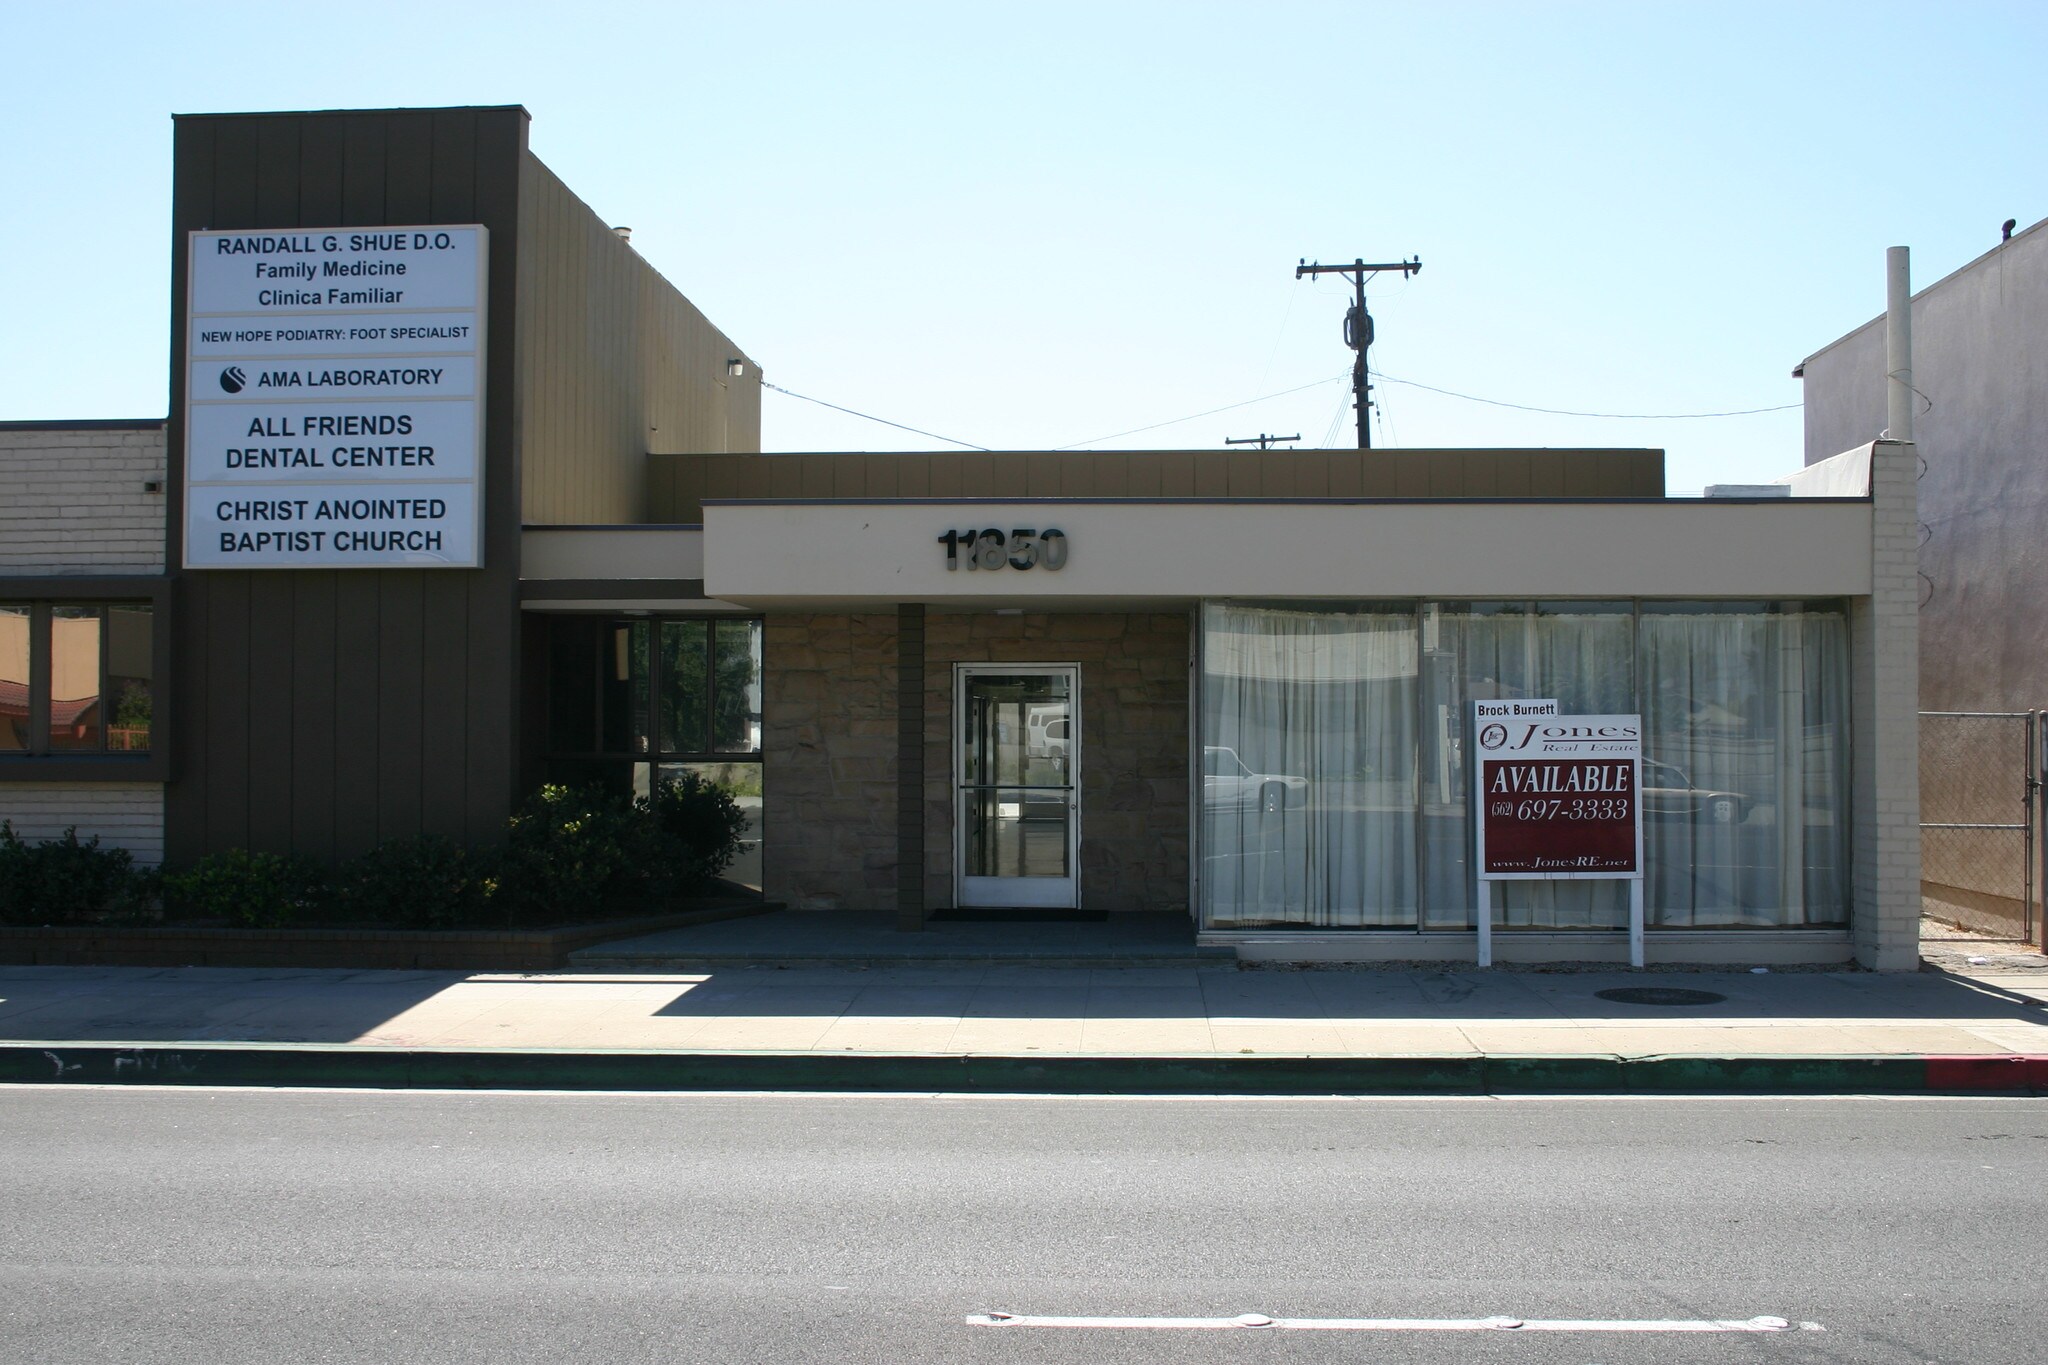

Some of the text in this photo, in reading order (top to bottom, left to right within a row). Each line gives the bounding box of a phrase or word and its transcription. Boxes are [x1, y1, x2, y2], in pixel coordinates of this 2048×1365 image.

[217, 233, 456, 255] RANDALL G. SHUE D.O.
[256, 260, 407, 281] Family Medicine
[258, 288, 403, 305] Clinica Familiar
[201, 326, 469, 343] NEW HOPE PODIATRY: FOOT SPECIALIST
[258, 369, 443, 388] AMA LABORATORY
[247, 415, 412, 437] ALL FRIENDS
[226, 446, 435, 468] DENTAL CENTER
[216, 499, 446, 521] CHRIST ANOINTED
[220, 530, 442, 552] BAPTIST CHURCH
[938, 528, 1068, 571] 11850
[1478, 704, 1555, 716] Brock Burnett
[1510, 724, 1638, 751] Jones
[1542, 743, 1638, 752] Real Estate
[1491, 765, 1629, 793] AVAILABLE
[1491, 799, 1628, 821] (562) 697-3333
[1493, 856, 1628, 869] www.JonesRE.net
